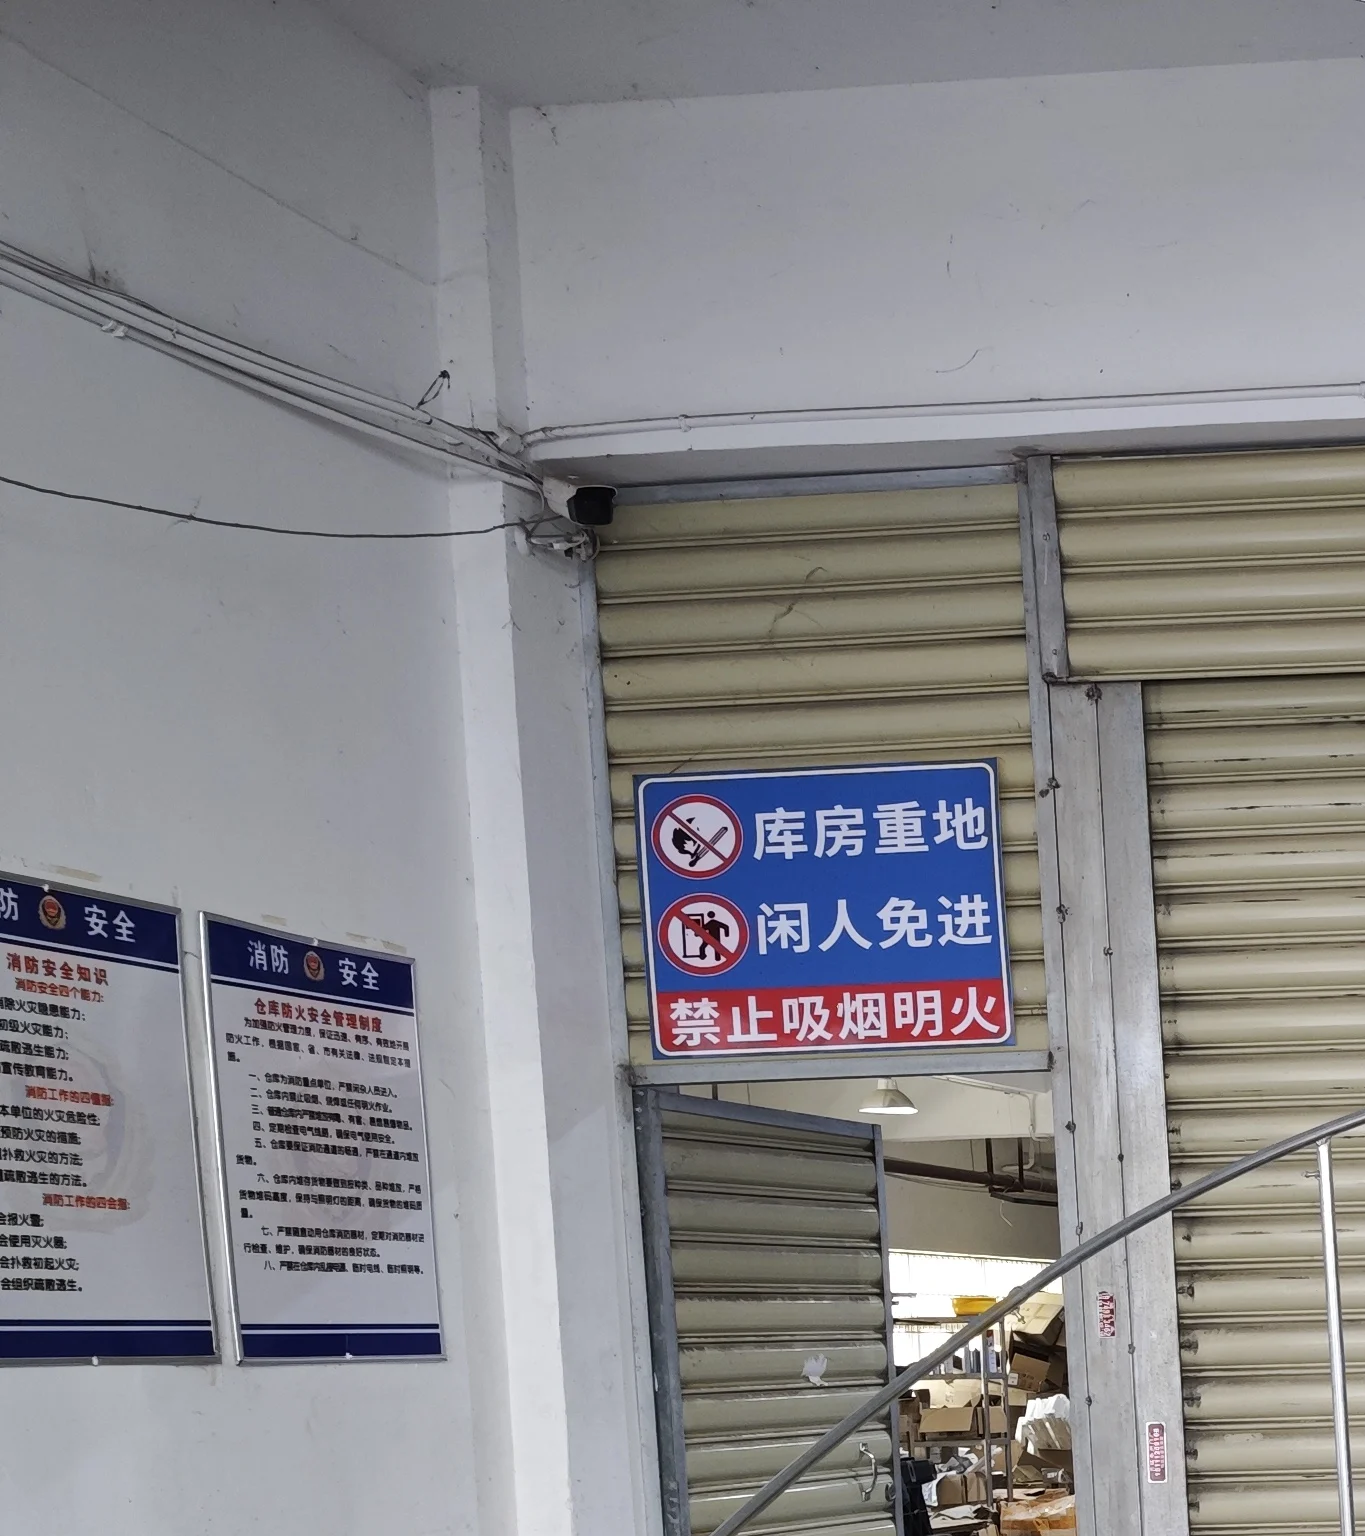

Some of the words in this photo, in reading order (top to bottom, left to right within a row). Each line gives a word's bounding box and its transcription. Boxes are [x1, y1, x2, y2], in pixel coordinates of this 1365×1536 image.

[752, 797, 989, 861] 库房重地
[84, 904, 136, 943] 安全
[756, 894, 993, 955] 闲人免进
[6, 952, 109, 986] 消防安全知识
[247, 940, 289, 975] 消防
[338, 958, 380, 991] 安全
[254, 997, 382, 1033] 仓库防火安全管理制度
[669, 986, 1001, 1047] 禁止吸烟明火
